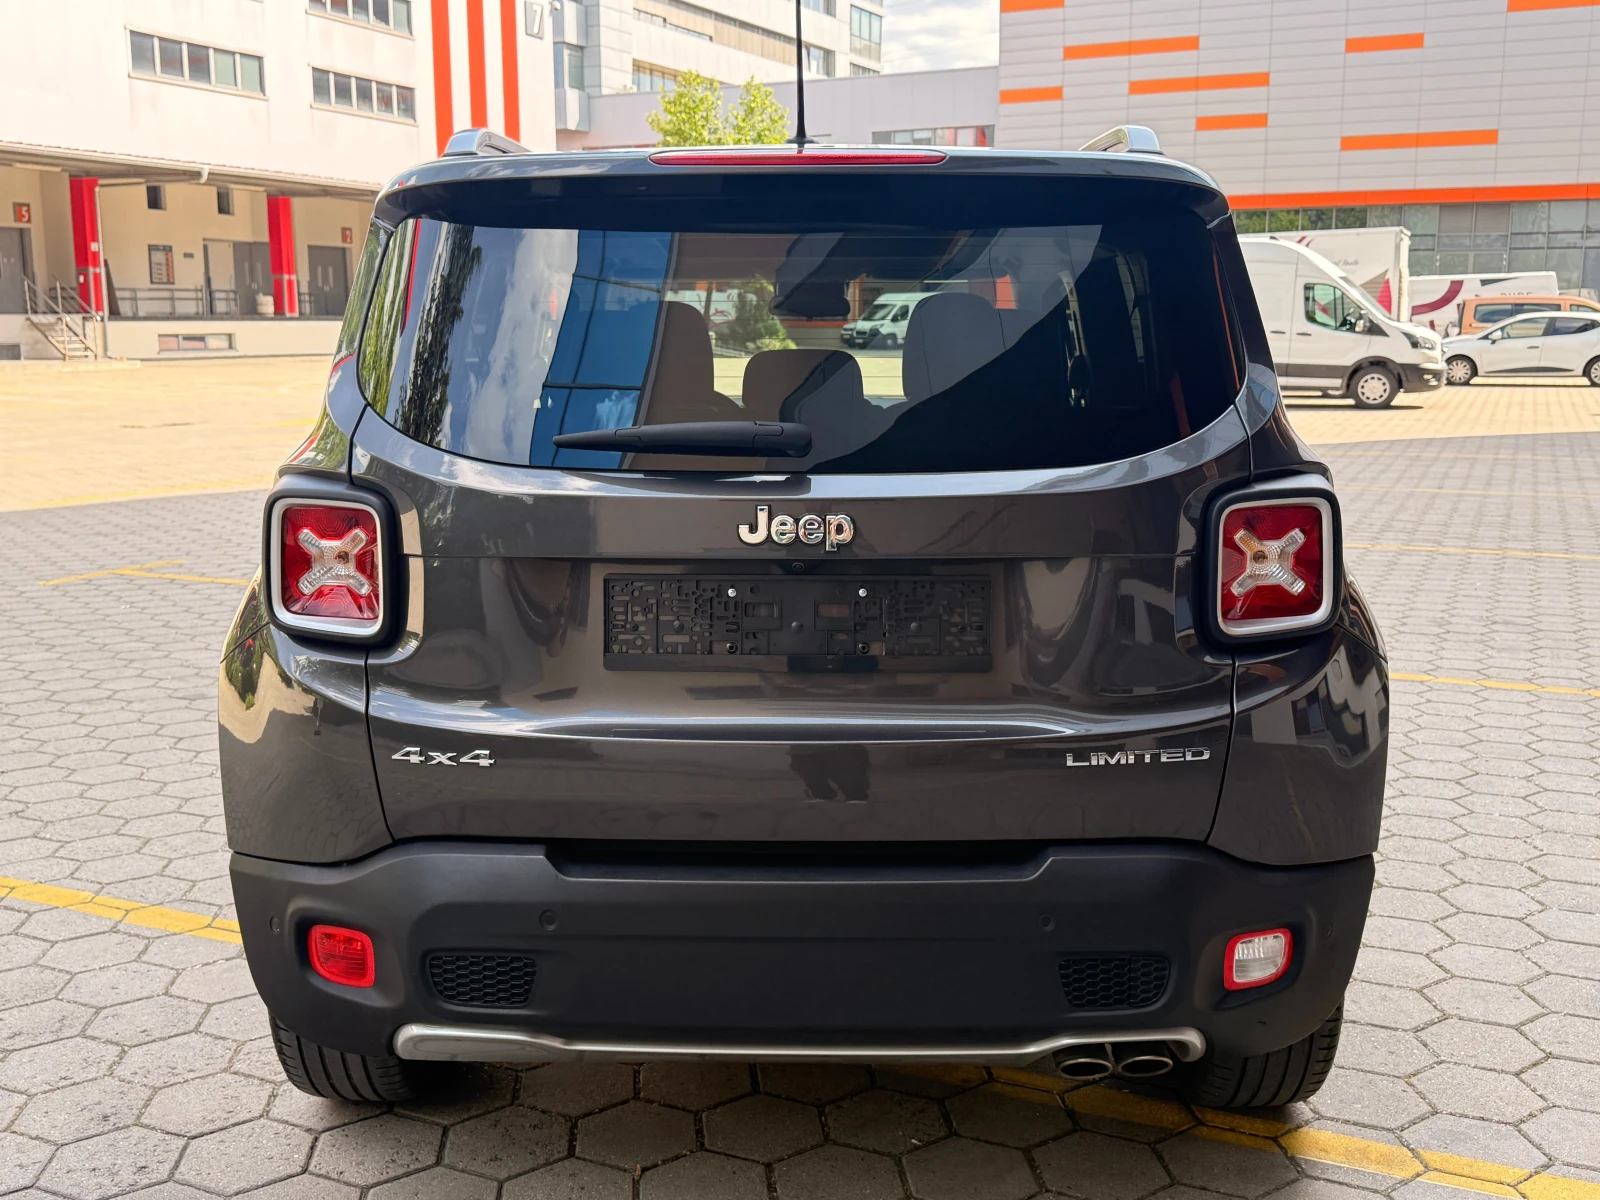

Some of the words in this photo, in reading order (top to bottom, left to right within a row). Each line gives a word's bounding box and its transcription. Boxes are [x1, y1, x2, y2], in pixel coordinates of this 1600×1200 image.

[532, 3, 543, 35] 7
[21, 206, 29, 222] 5
[738, 505, 854, 551] Jeep
[391, 746, 496, 767] 4x4
[1065, 746, 1211, 767] LIMITED
